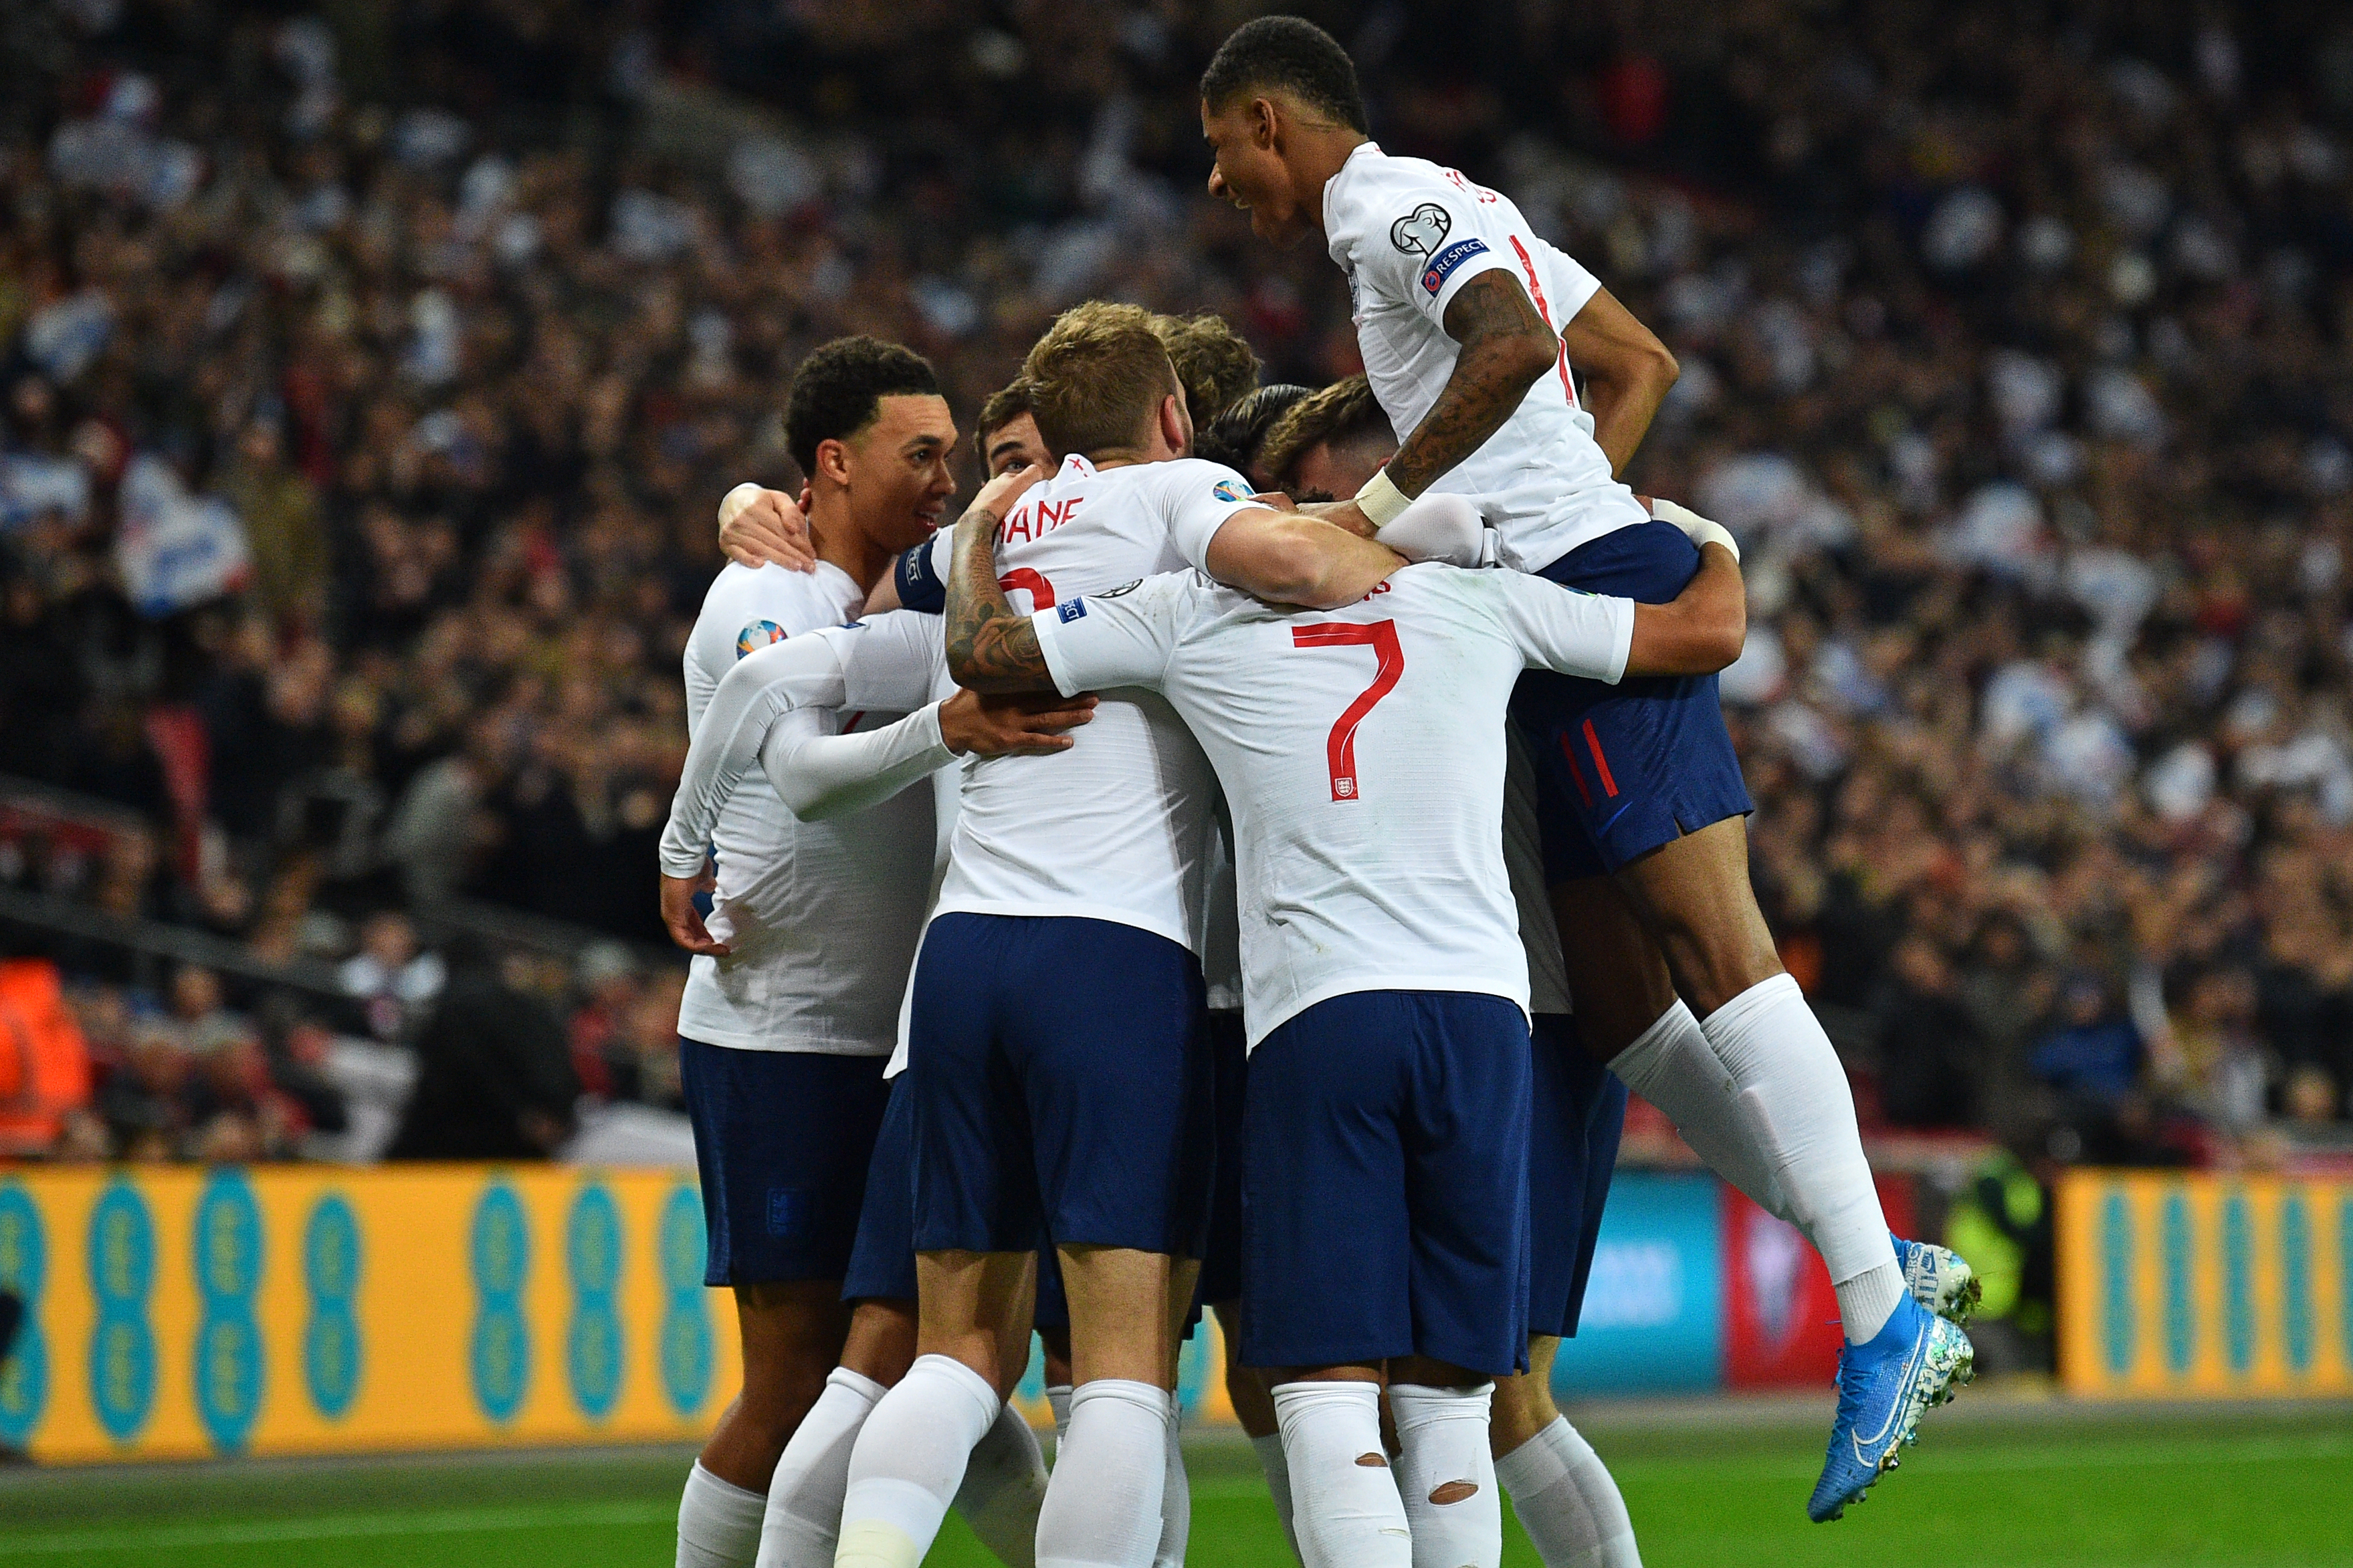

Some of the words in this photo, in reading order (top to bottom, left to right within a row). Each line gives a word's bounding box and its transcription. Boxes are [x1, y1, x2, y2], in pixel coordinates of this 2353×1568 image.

[1435, 241, 1485, 274] RESPECT
[1291, 618, 1405, 802] 7
[1560, 718, 1619, 809] 11
